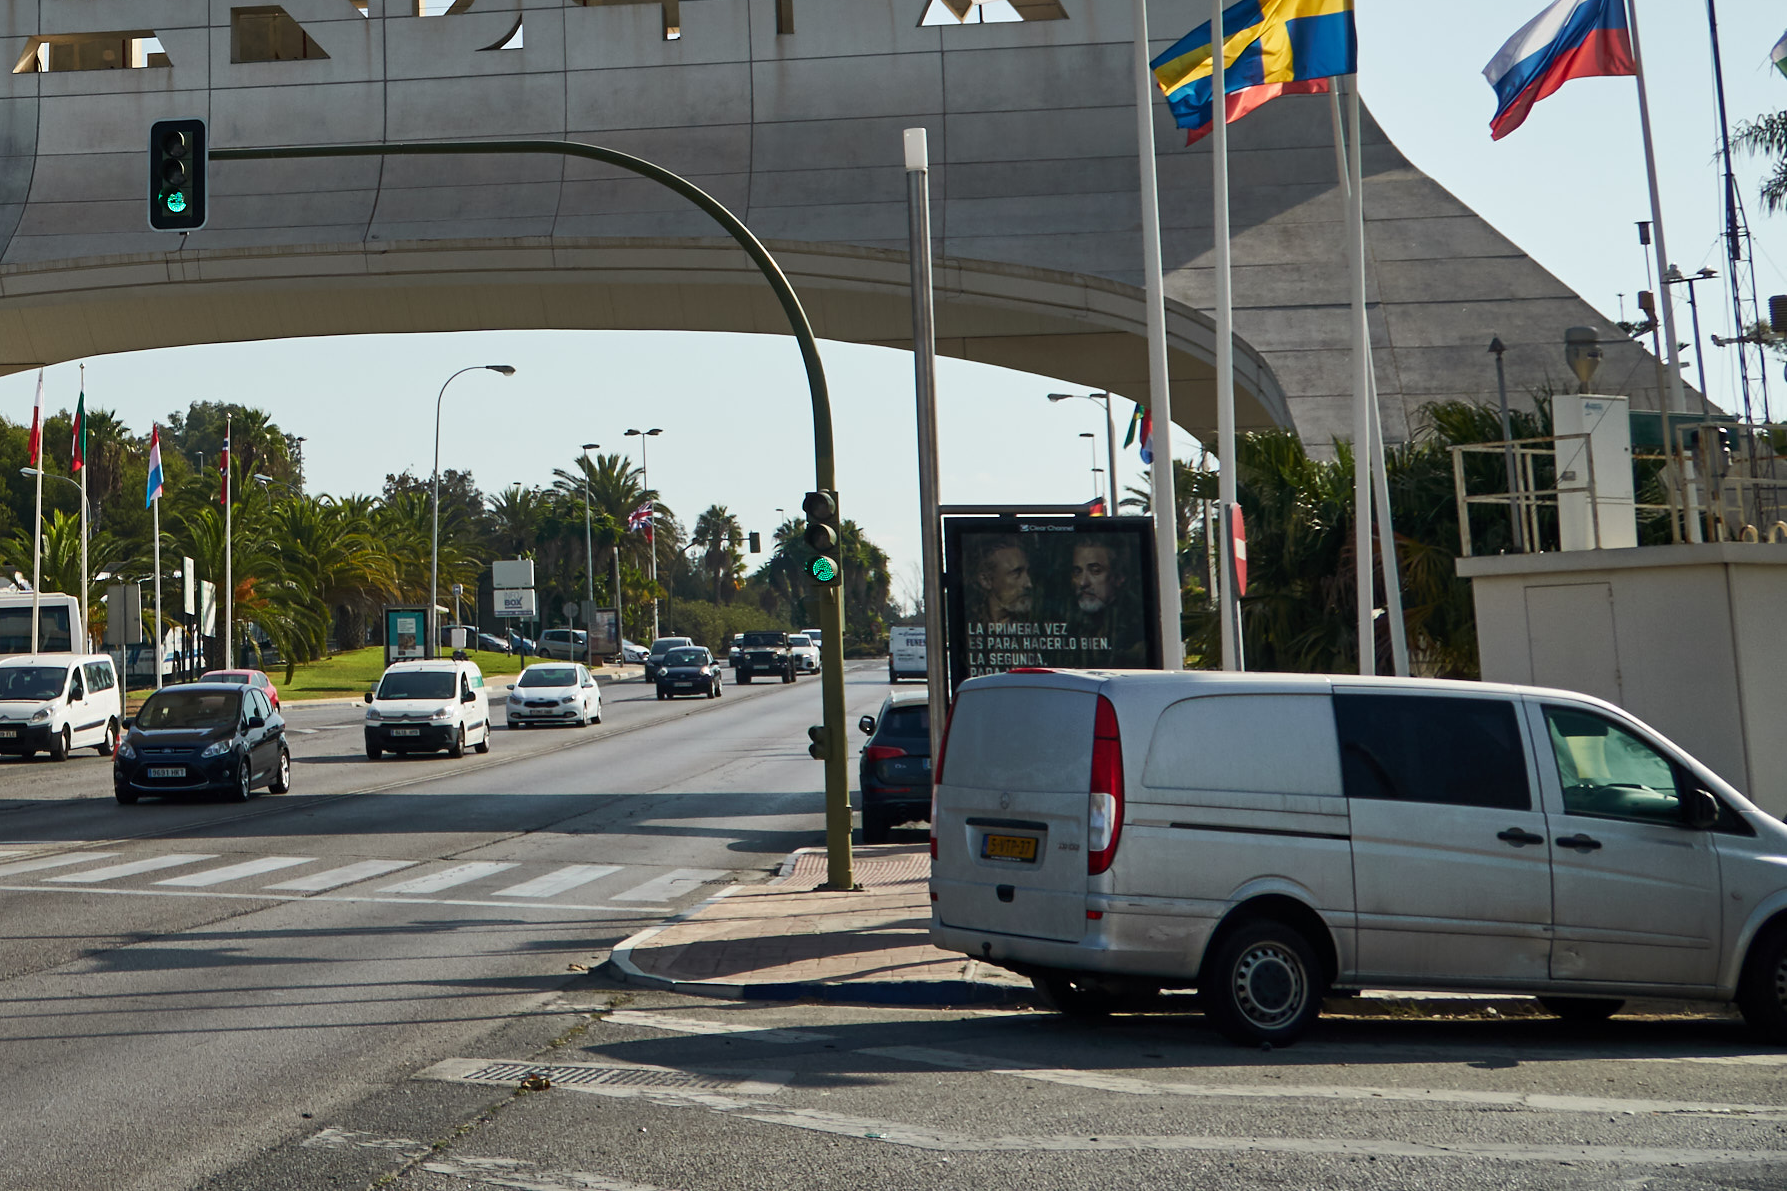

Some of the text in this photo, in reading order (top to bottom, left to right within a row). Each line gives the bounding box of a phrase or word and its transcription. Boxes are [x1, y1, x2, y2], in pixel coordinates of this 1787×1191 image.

[1030, 524, 1075, 532] Clear Channel
[505, 597, 523, 606] BOX
[968, 622, 1068, 635] LA PRIMERA VEZ
[969, 637, 1112, 650] ES PARA HACERLO BIEN.
[969, 652, 985, 665] LA
